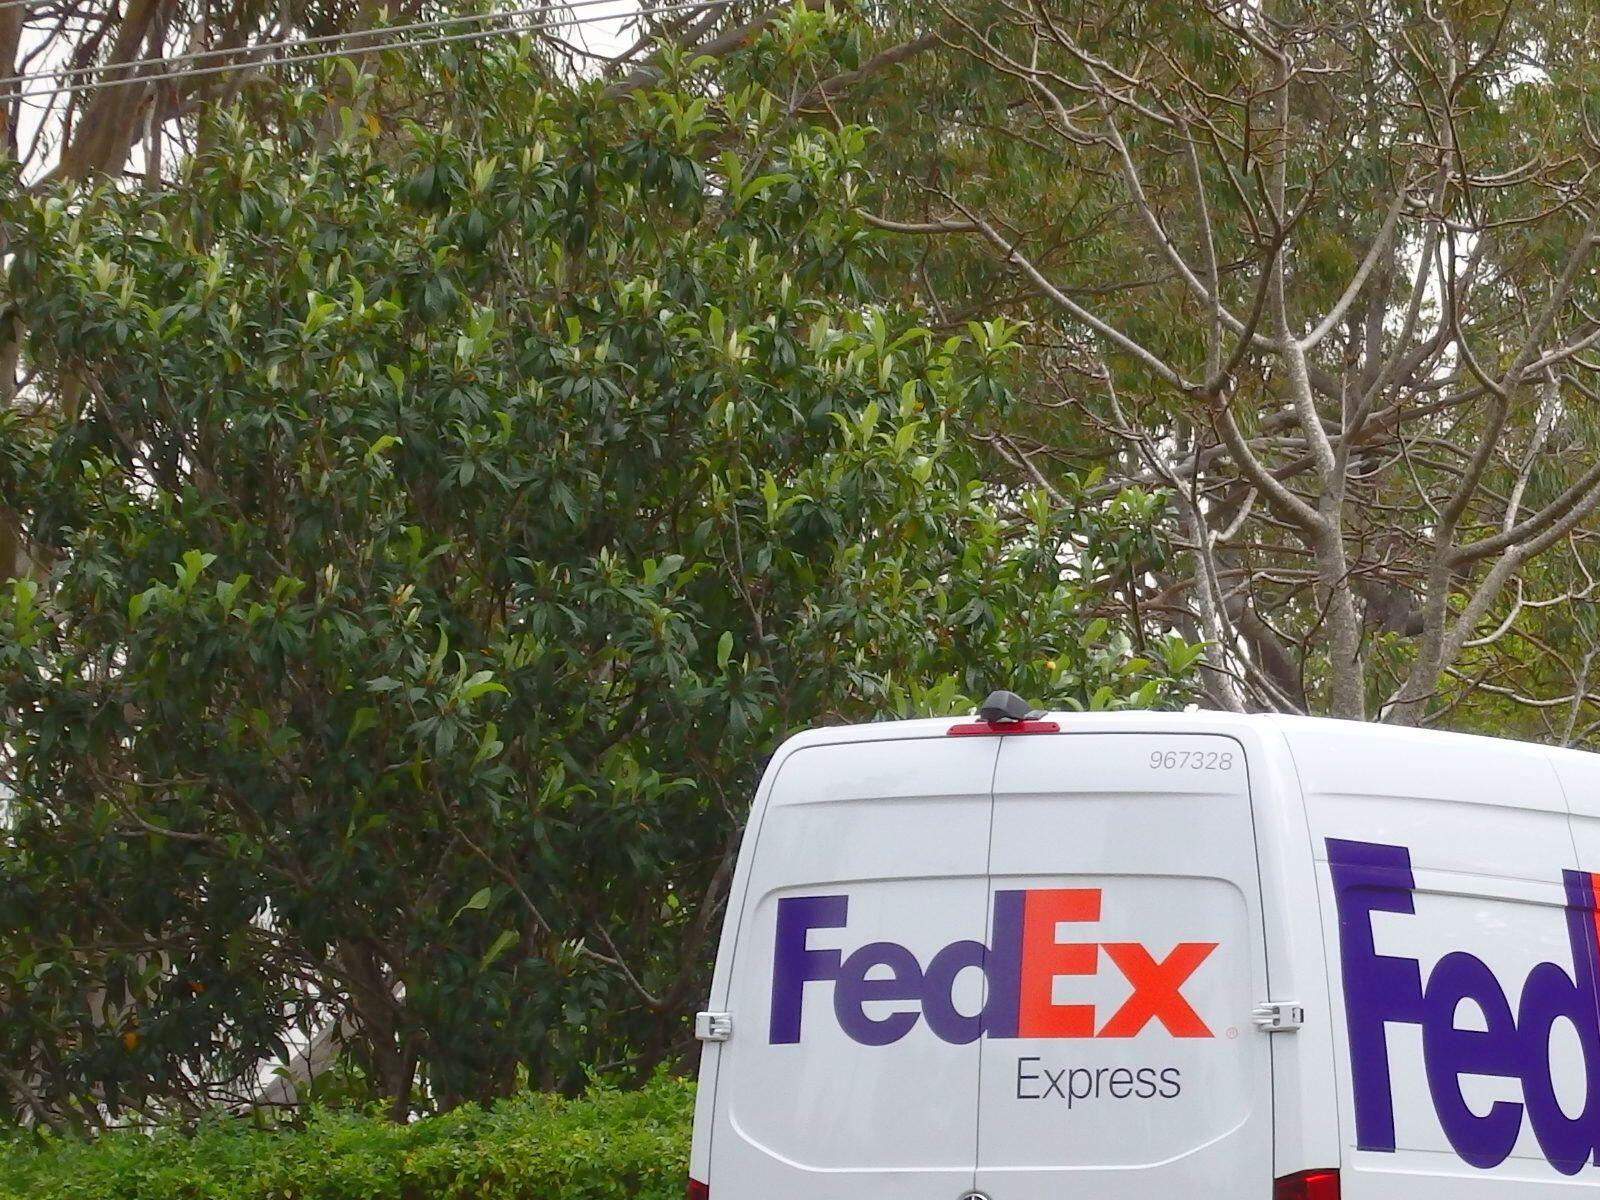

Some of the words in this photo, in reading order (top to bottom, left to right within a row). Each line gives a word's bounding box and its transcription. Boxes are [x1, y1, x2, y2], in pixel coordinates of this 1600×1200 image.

[1149, 750, 1233, 771] 967328
[769, 888, 1219, 1046] FedEx
[1016, 1056, 1181, 1110] Express
